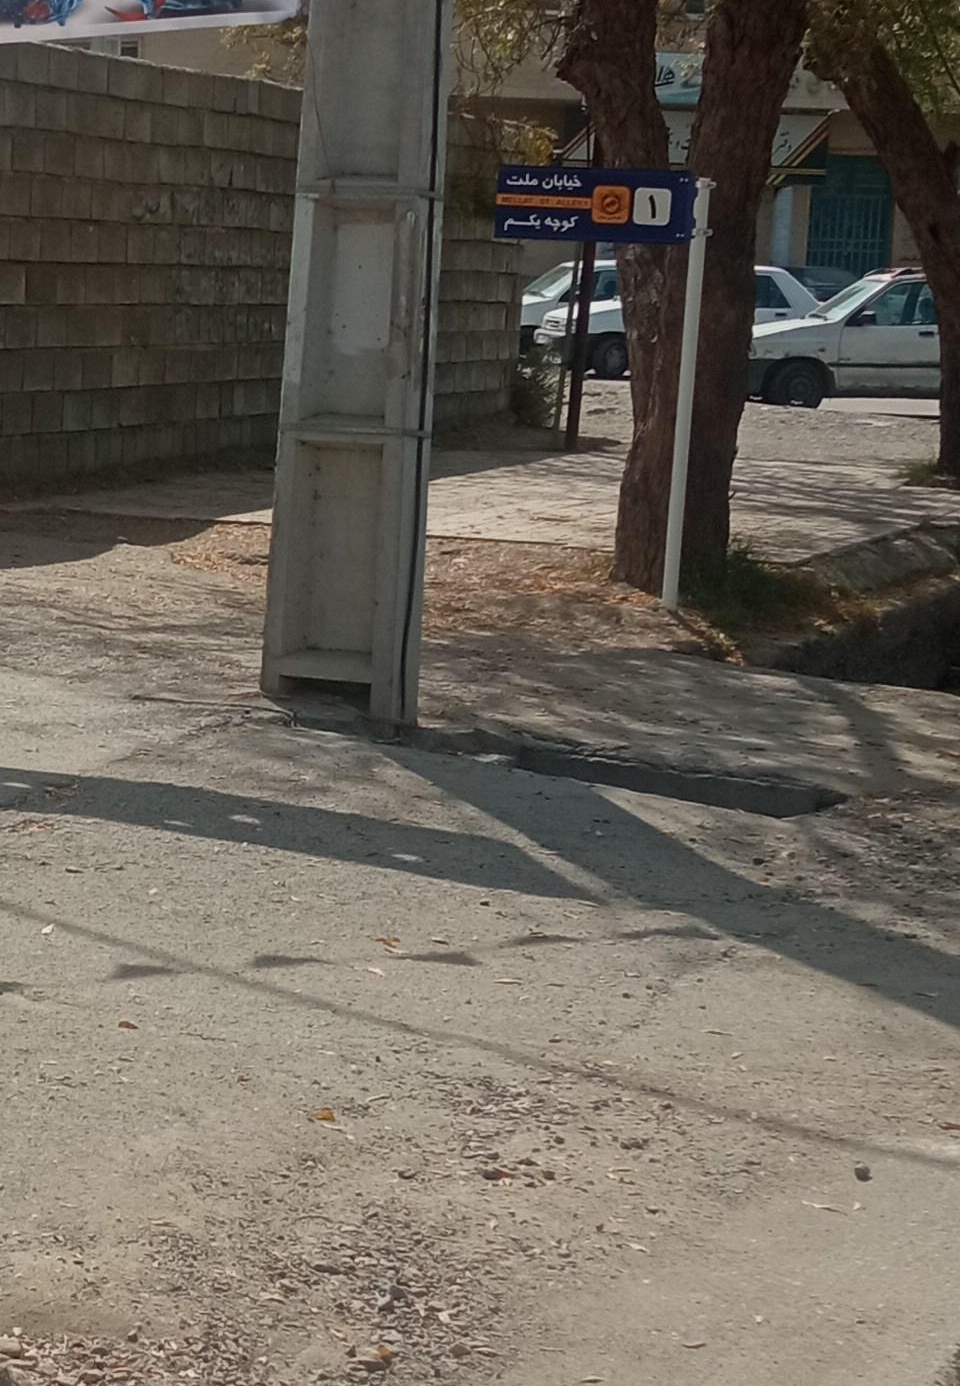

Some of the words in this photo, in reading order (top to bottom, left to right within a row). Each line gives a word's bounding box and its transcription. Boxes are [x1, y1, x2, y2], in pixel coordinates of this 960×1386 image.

[505, 173, 539, 187] ملت
[542, 173, 583, 190] خیابان
[501, 196, 534, 206] MELLAT
[647, 194, 657, 220] ۱
[544, 215, 579, 232] کوچه
